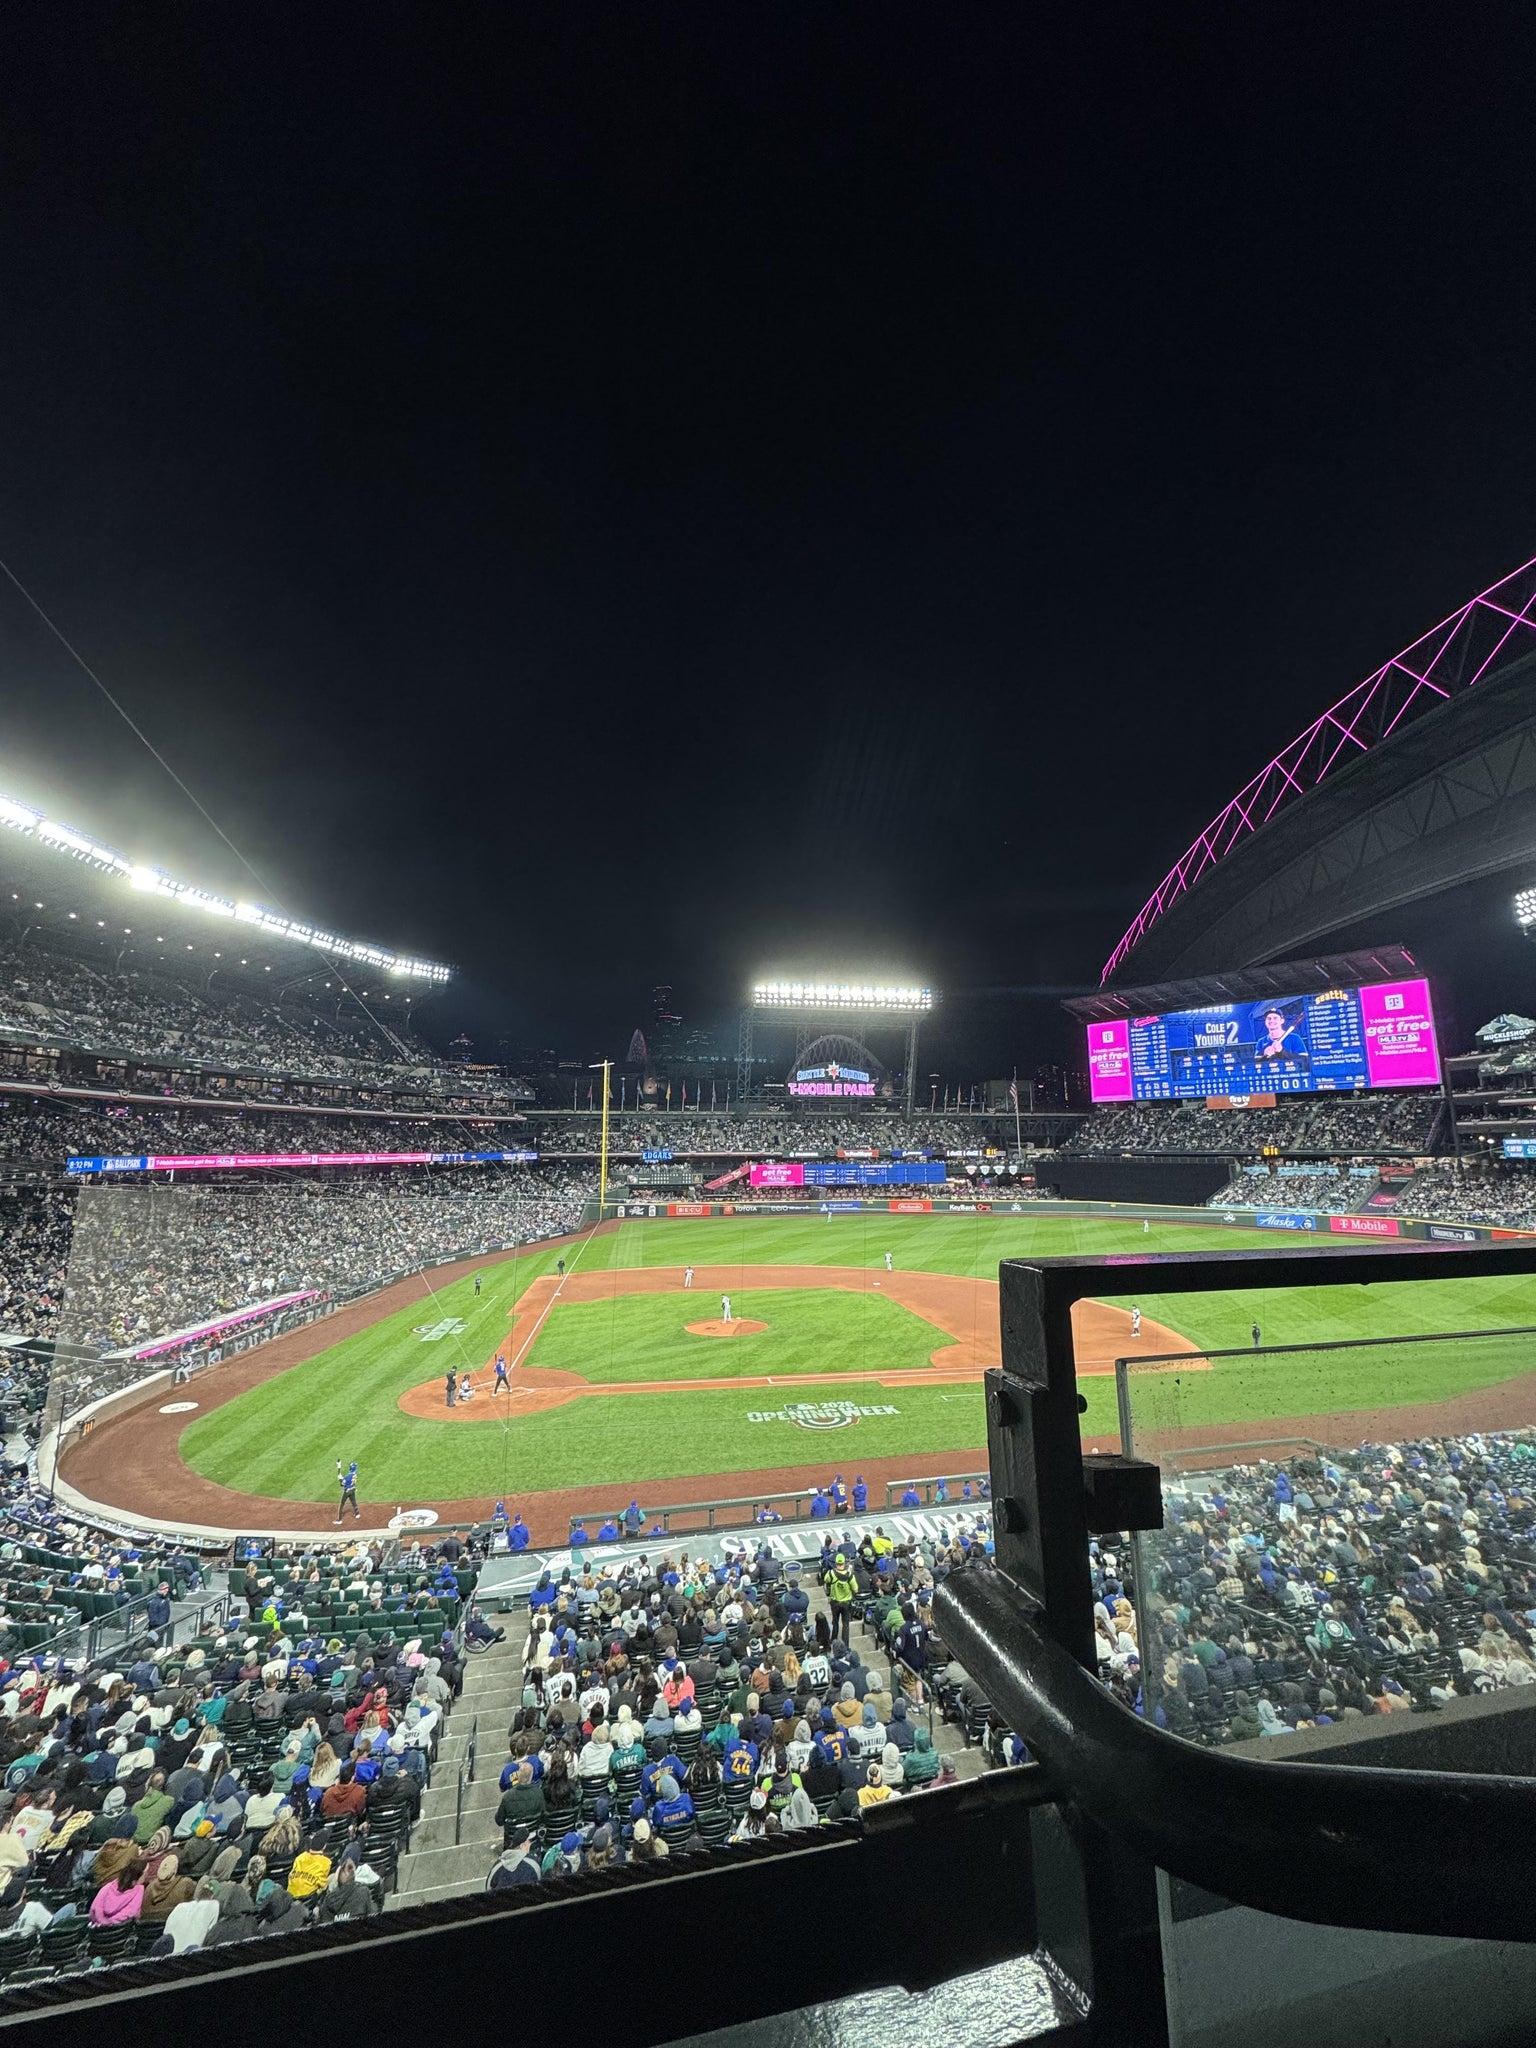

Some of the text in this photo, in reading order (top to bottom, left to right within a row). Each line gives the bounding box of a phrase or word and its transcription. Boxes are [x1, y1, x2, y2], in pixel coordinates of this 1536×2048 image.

[1316, 989, 1349, 1005] seattle
[1226, 1021, 1239, 1045] 2
[1367, 1021, 1430, 1037] get free
[1484, 1028, 1535, 1041] MUCKLESHOOT
[1090, 1052, 1129, 1063] get free
[797, 1068, 826, 1081] SEATTLE
[788, 1083, 876, 1096] T-MOBILE PARK
[1282, 1078, 1309, 1089] 0 0 1
[643, 1151, 673, 1160] EDGARS
[69, 1161, 84, 1169] 8:32
[115, 1159, 142, 1168] BALLPARK
[950, 1204, 977, 1212] KeyBank
[1260, 1215, 1296, 1228] Alaska
[1352, 1220, 1388, 1232] Mobile
[747, 1405, 902, 1422] OPENING WEEK
[720, 1525, 880, 1561] SEATTLE
[915, 1634, 920, 1649] 1
[810, 1668, 826, 1684] 32
[860, 1738, 886, 1750] MARTINEZ
[832, 1742, 843, 1761] 3
[616, 1754, 639, 1769] FRANCE
[732, 1758, 751, 1776] 44
[663, 1811, 687, 1823] REYNOLDS
